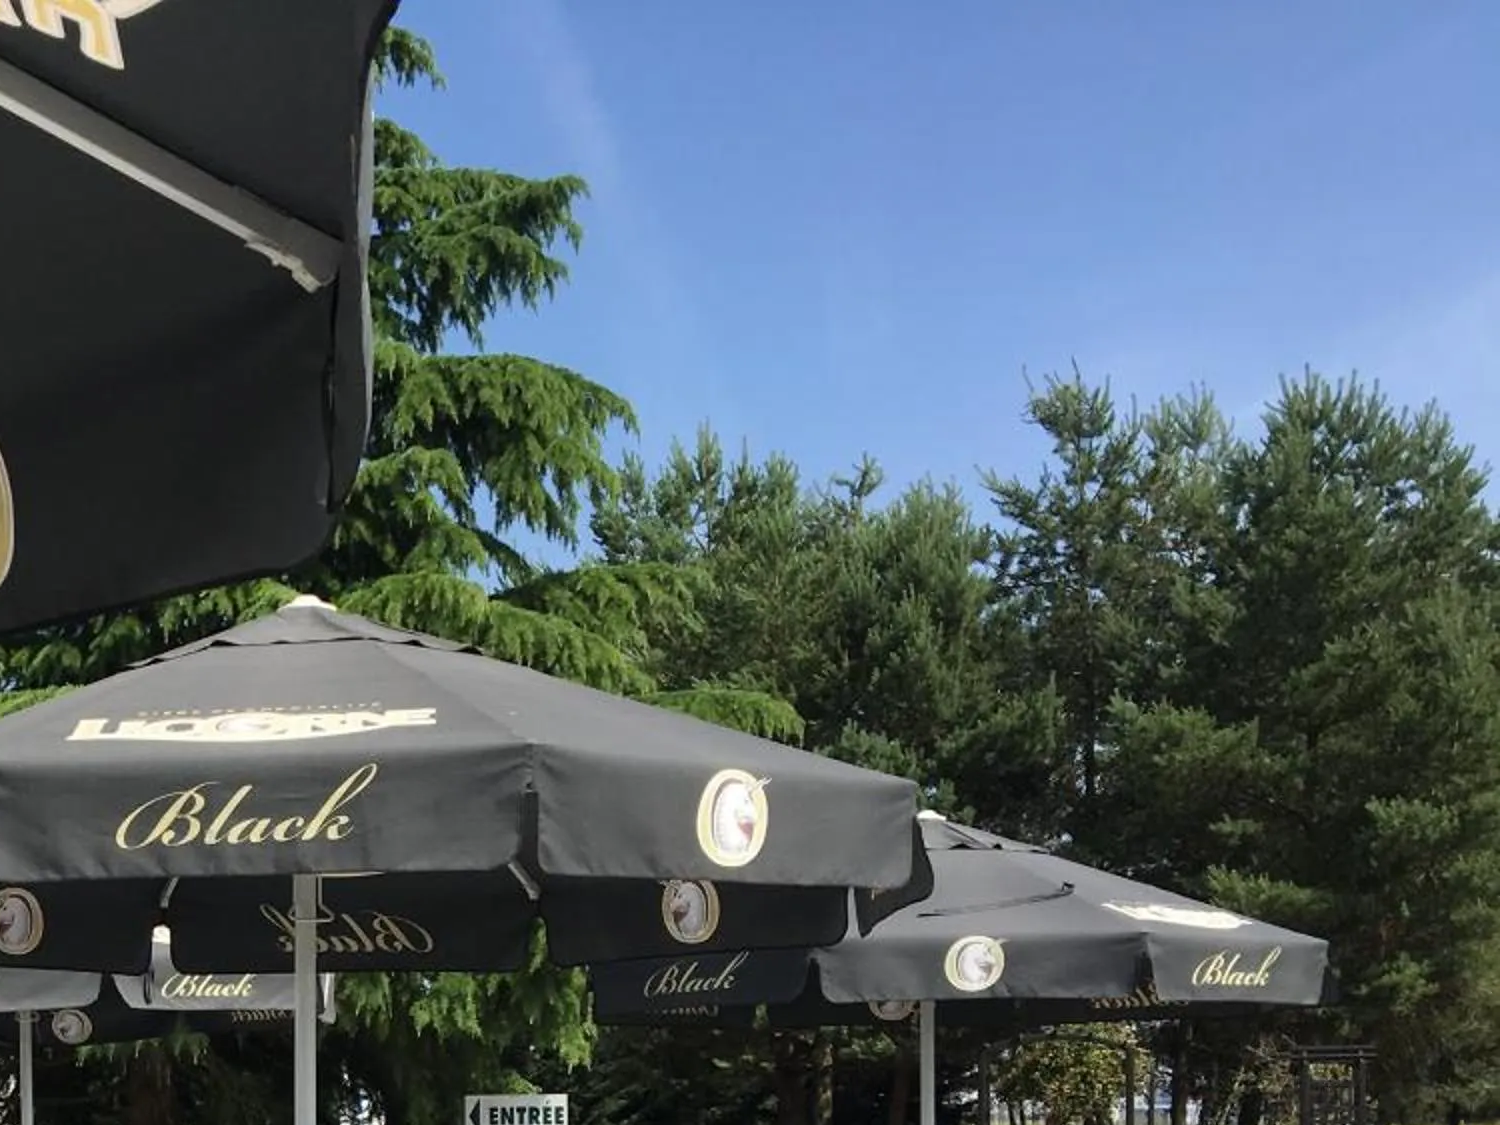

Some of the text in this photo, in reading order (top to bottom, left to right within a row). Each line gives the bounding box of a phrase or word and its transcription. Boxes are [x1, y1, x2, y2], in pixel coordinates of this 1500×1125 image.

[115, 763, 378, 850] Black
[161, 973, 258, 998] Black
[643, 950, 750, 999] Black
[1191, 946, 1283, 988] Black
[488, 1100, 565, 1125] ENTRÉE
